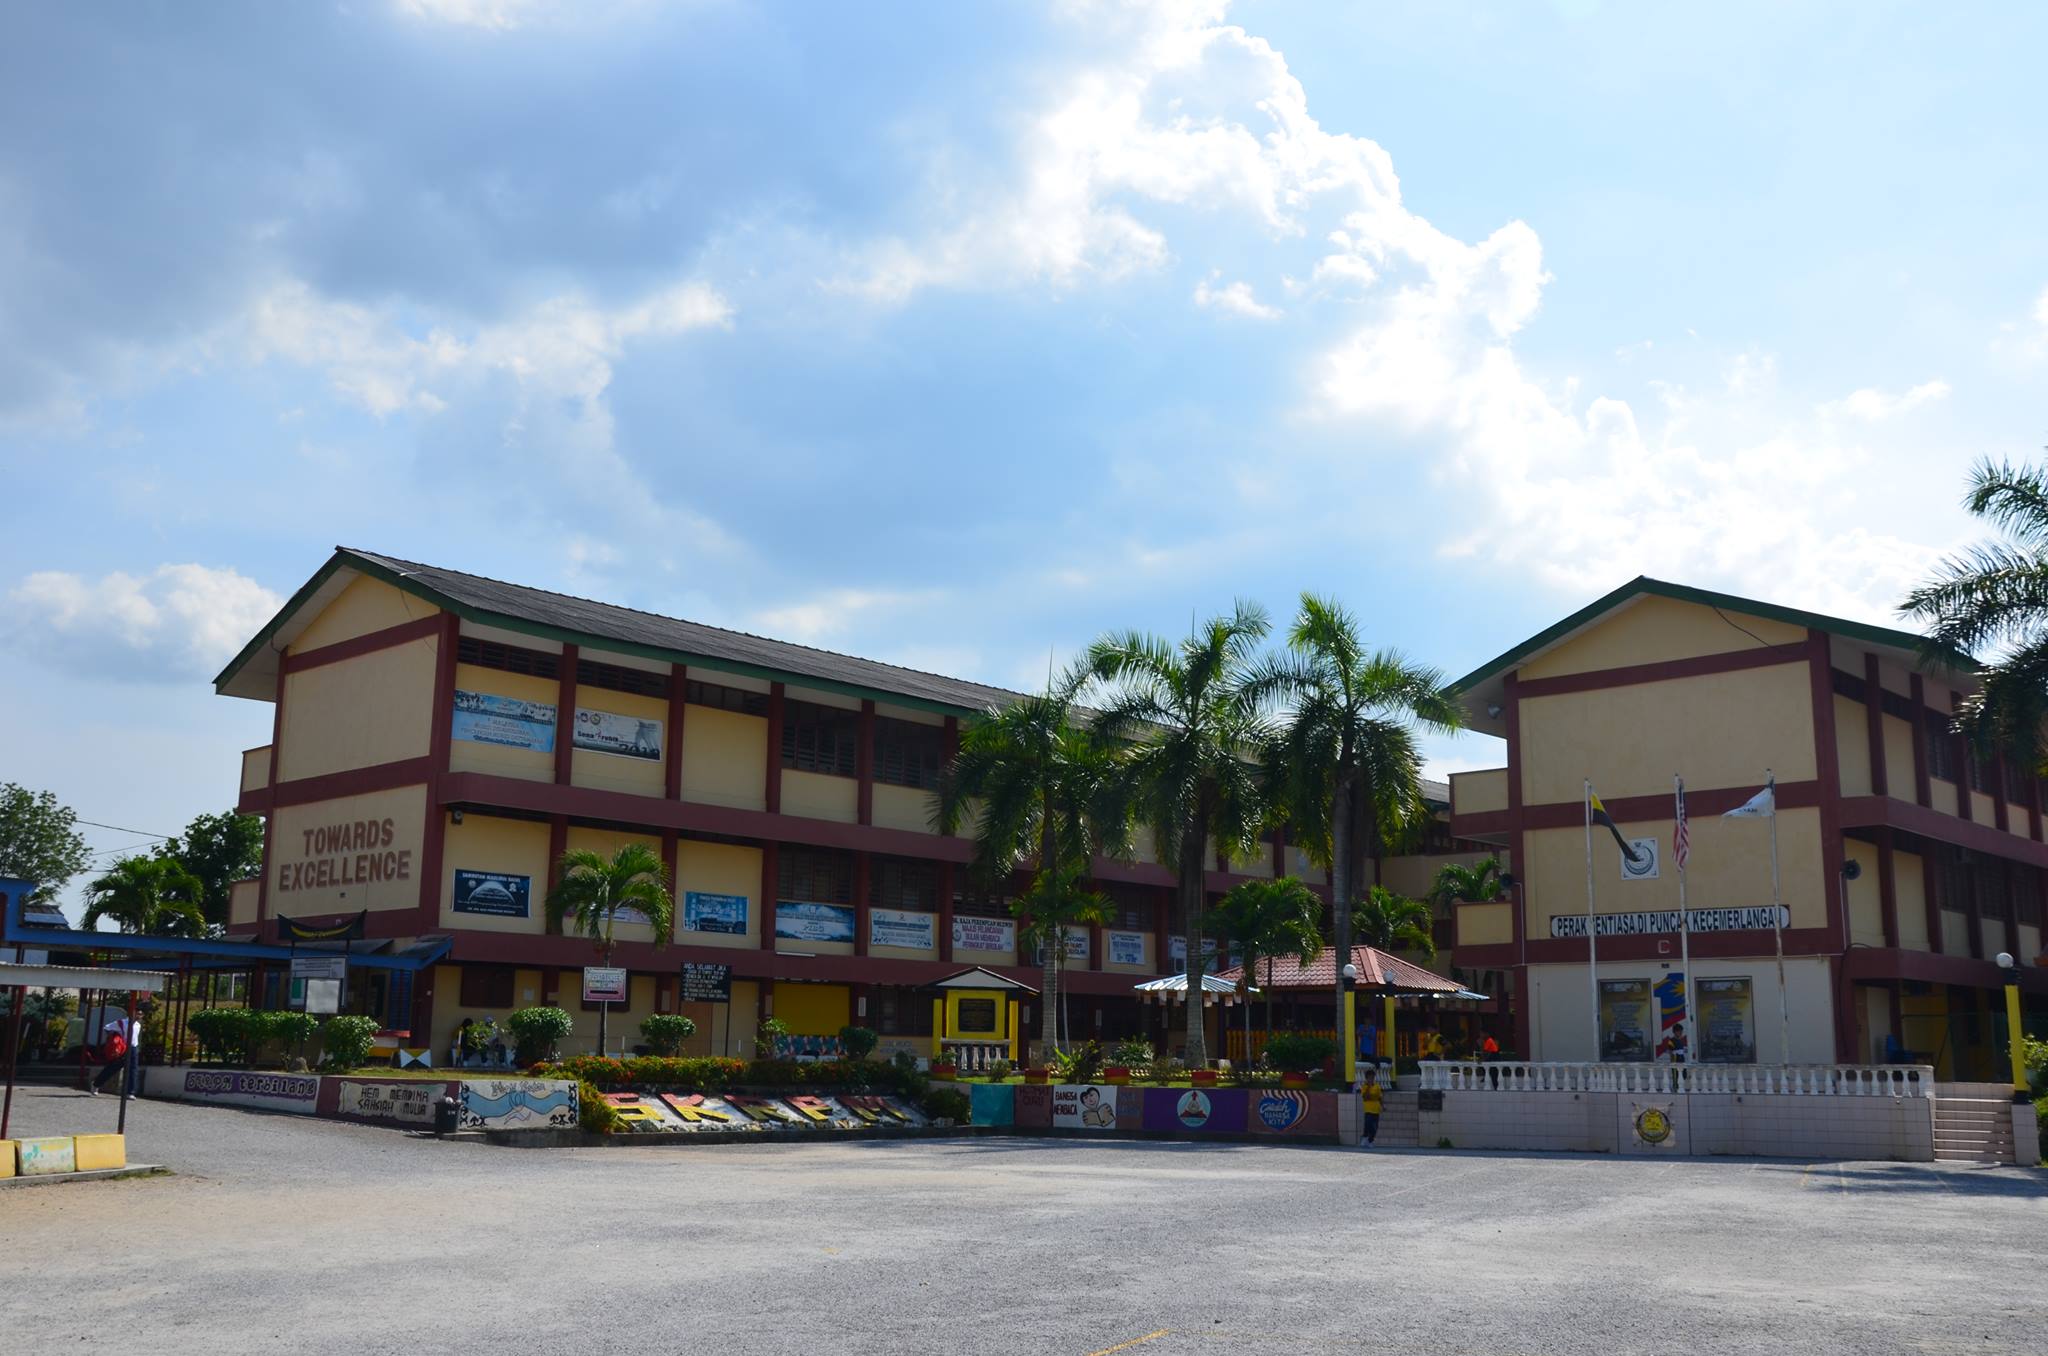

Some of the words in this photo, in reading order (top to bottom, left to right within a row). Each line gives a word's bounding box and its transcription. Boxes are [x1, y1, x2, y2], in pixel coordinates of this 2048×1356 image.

[303, 818, 394, 857] TOWARDS
[279, 849, 412, 892] EXCELLENCE
[1557, 917, 1587, 936] PERAK
[1590, 914, 1635, 935] ENTIASA
[1638, 914, 1647, 933] DI
[1650, 911, 1690, 932] PUNCAK
[239, 1075, 316, 1097] terbilang
[1055, 1091, 1077, 1101] BANGSA
